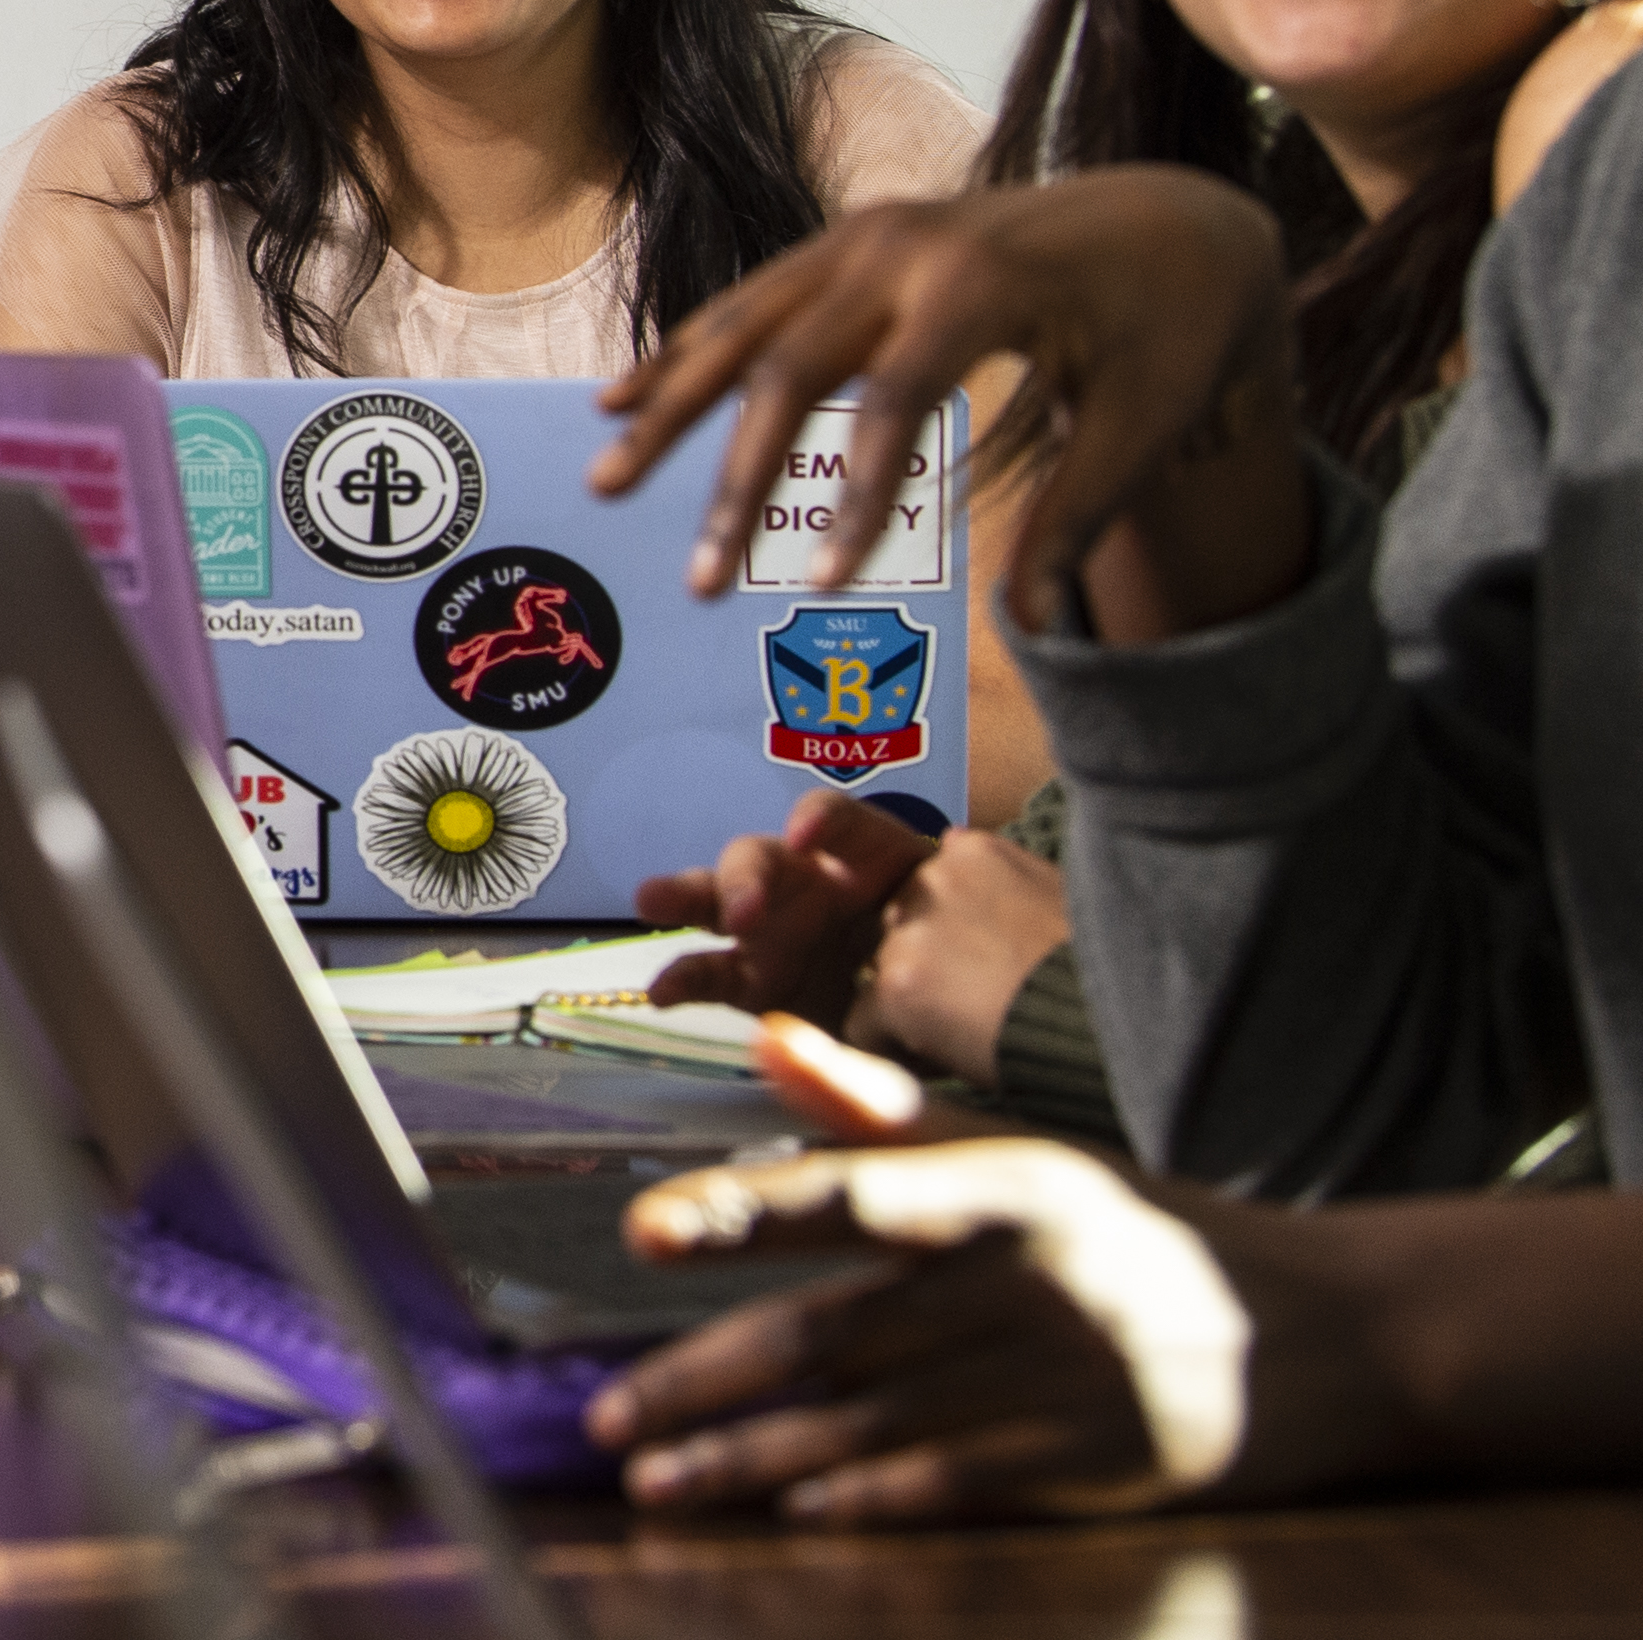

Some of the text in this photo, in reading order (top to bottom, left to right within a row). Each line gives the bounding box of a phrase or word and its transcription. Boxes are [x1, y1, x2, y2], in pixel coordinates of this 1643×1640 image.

[284, 396, 481, 550] CROSSPOINT COMMUNITY CHURCH
[787, 453, 929, 479] EMD
[765, 505, 924, 532] DIGY
[436, 565, 529, 635] PONY UP
[826, 617, 867, 633] SMU
[511, 680, 568, 712] SMU
[818, 656, 873, 727] B
[802, 737, 890, 762] BOAZ
